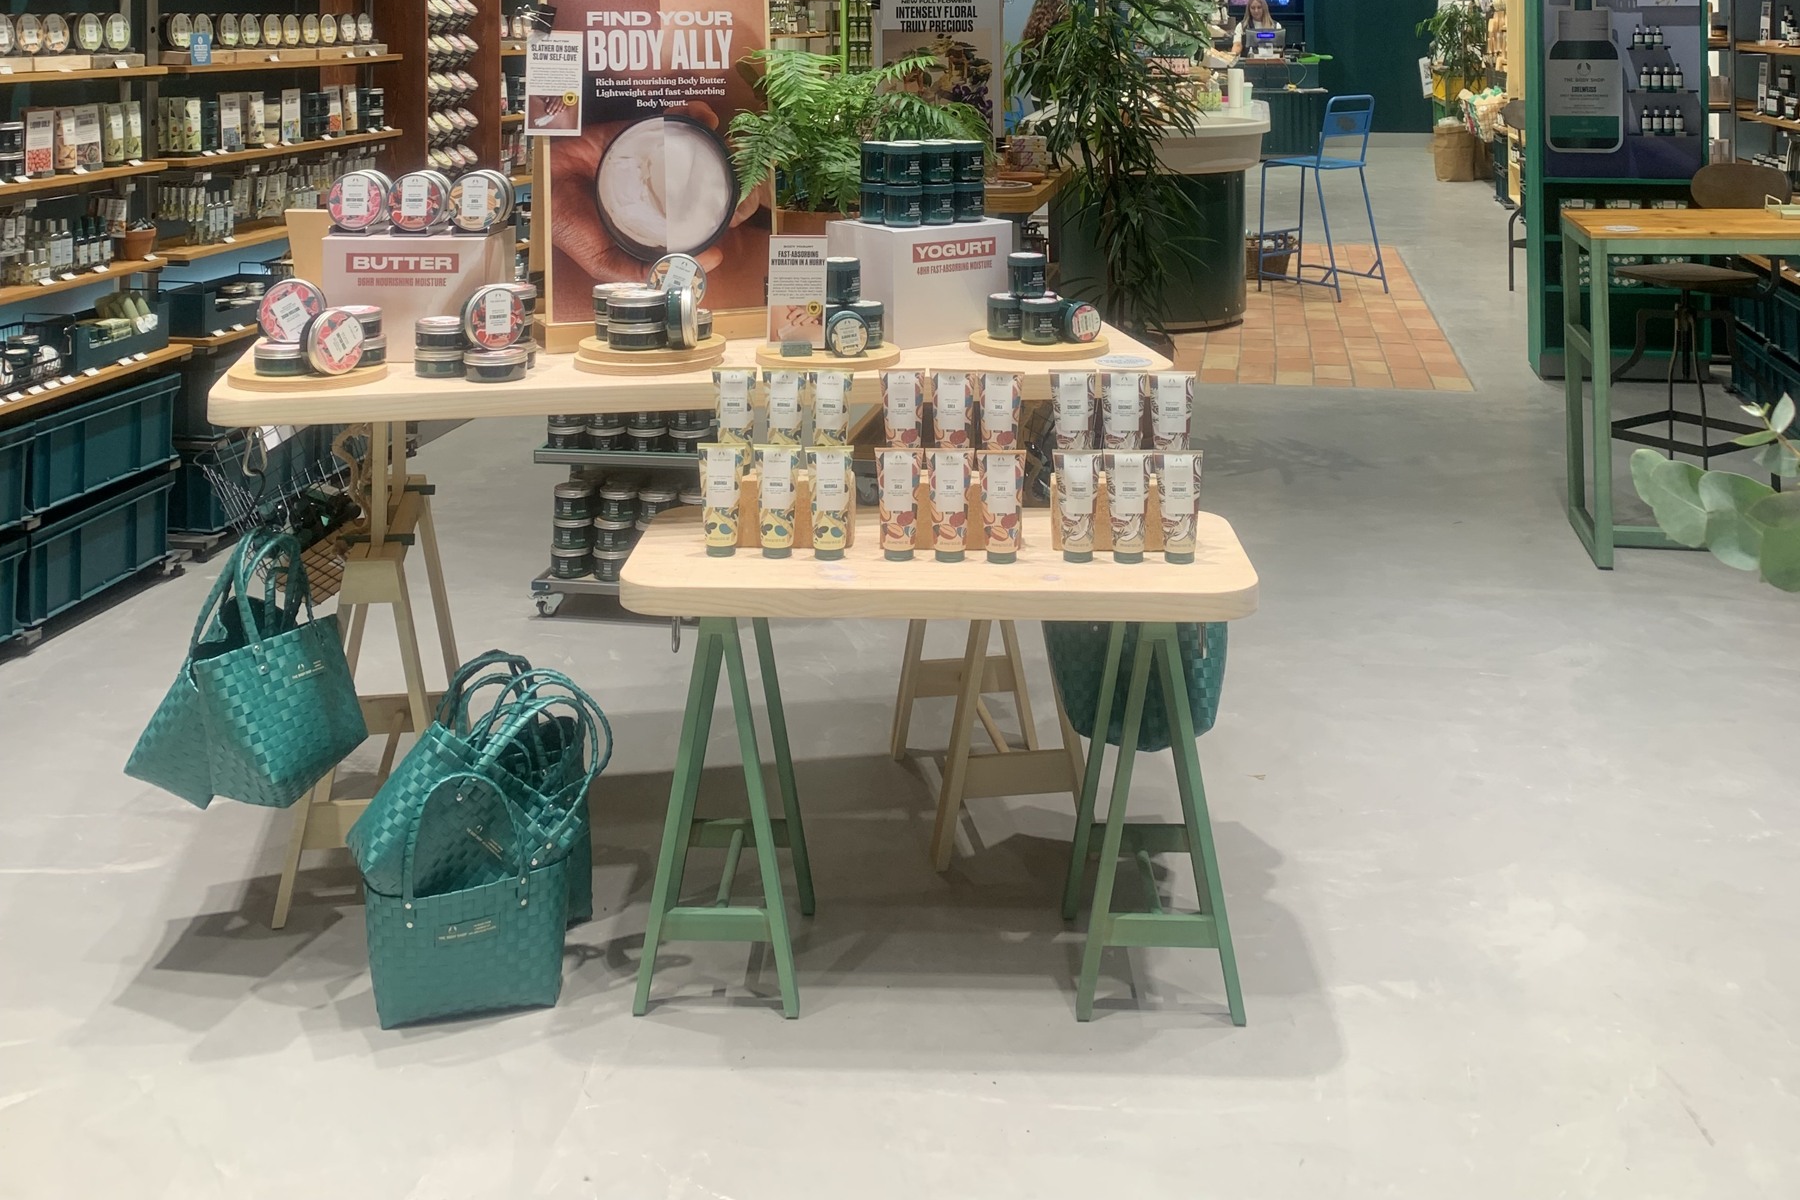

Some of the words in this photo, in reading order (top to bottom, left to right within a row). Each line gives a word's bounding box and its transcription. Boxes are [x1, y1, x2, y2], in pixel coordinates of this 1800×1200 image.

[586, 11, 651, 26] FIND
[656, 10, 733, 26] YOUR
[896, 6, 942, 19] INTENSELY
[944, 5, 978, 18] FLORAL
[900, 20, 927, 33] TRULY
[929, 20, 974, 32] PRECIOUS
[531, 44, 554, 52] SLATHER
[564, 45, 579, 53] SOME
[587, 30, 664, 71] BODY
[671, 29, 733, 70] ALLY
[549, 53, 577, 61] SELF-LOVE
[595, 77, 614, 86] Rich
[615, 78, 631, 86] and
[633, 77, 677, 87] nourishing
[678, 77, 699, 86] Body
[699, 76, 726, 85] Butter.
[596, 88, 646, 98] Lightweight
[647, 88, 663, 96] and
[665, 87, 725, 96] fast-absorbing
[636, 99, 658, 108] Body
[659, 99, 688, 107] Yogurt.
[778, 250, 819, 258] FAST-ABSORBING
[915, 240, 993, 260] YOGURT
[353, 256, 452, 270] BUTTER
[917, 266, 930, 276] 48HR
[930, 262, 969, 275] FAST-ABSORBING
[970, 260, 993, 270] MOISTURE
[357, 277, 375, 287] 96HR
[375, 277, 414, 287] NOURISHING
[415, 277, 447, 287] MOISTURE
